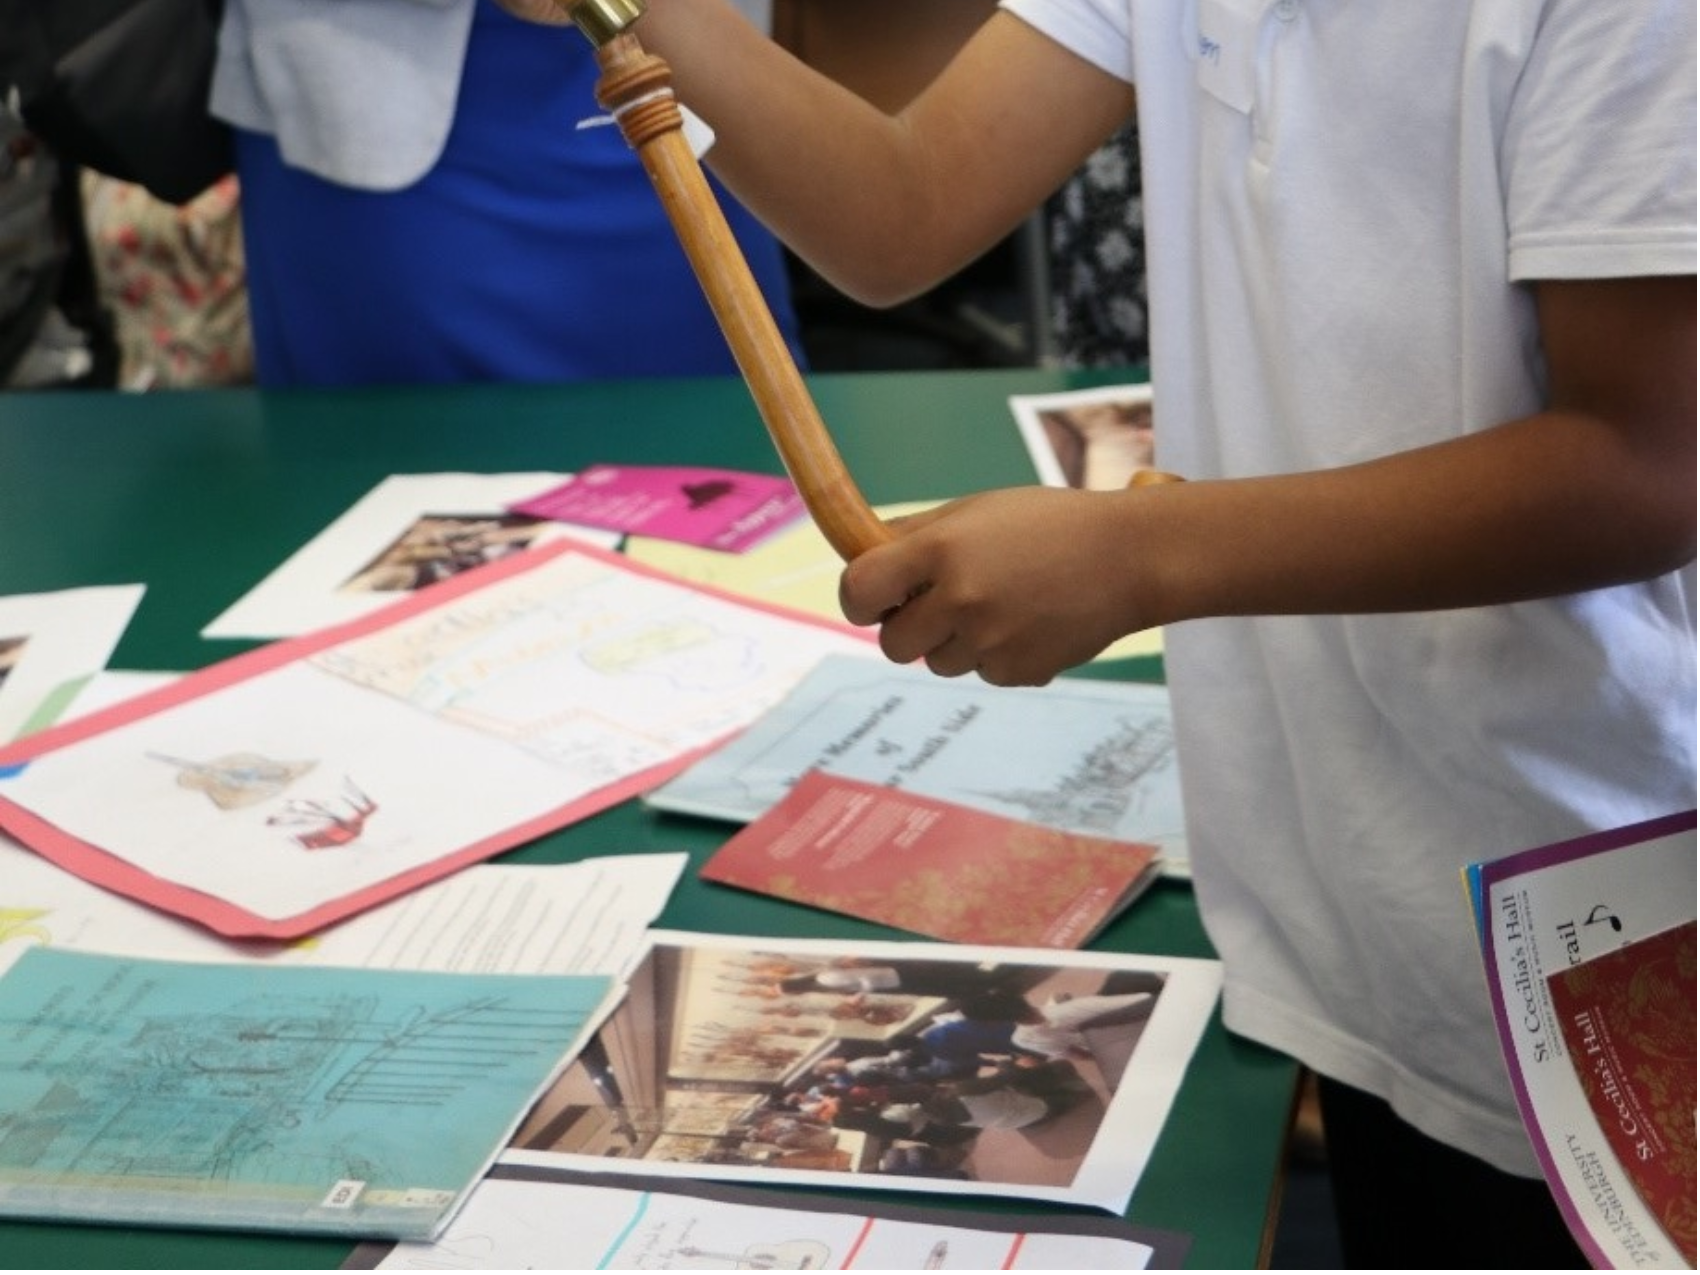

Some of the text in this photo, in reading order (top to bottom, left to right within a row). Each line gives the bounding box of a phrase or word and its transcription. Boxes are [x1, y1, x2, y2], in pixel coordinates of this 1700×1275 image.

[1502, 892, 1550, 1063] St Cecilia's Hall
[1556, 920, 1581, 966] rail
[1574, 1011, 1655, 1160] St Cecilia's Hall
[1566, 1133, 1646, 1266] THE UNIVERSITY
[1585, 1151, 1648, 1248] EDINBURGH
